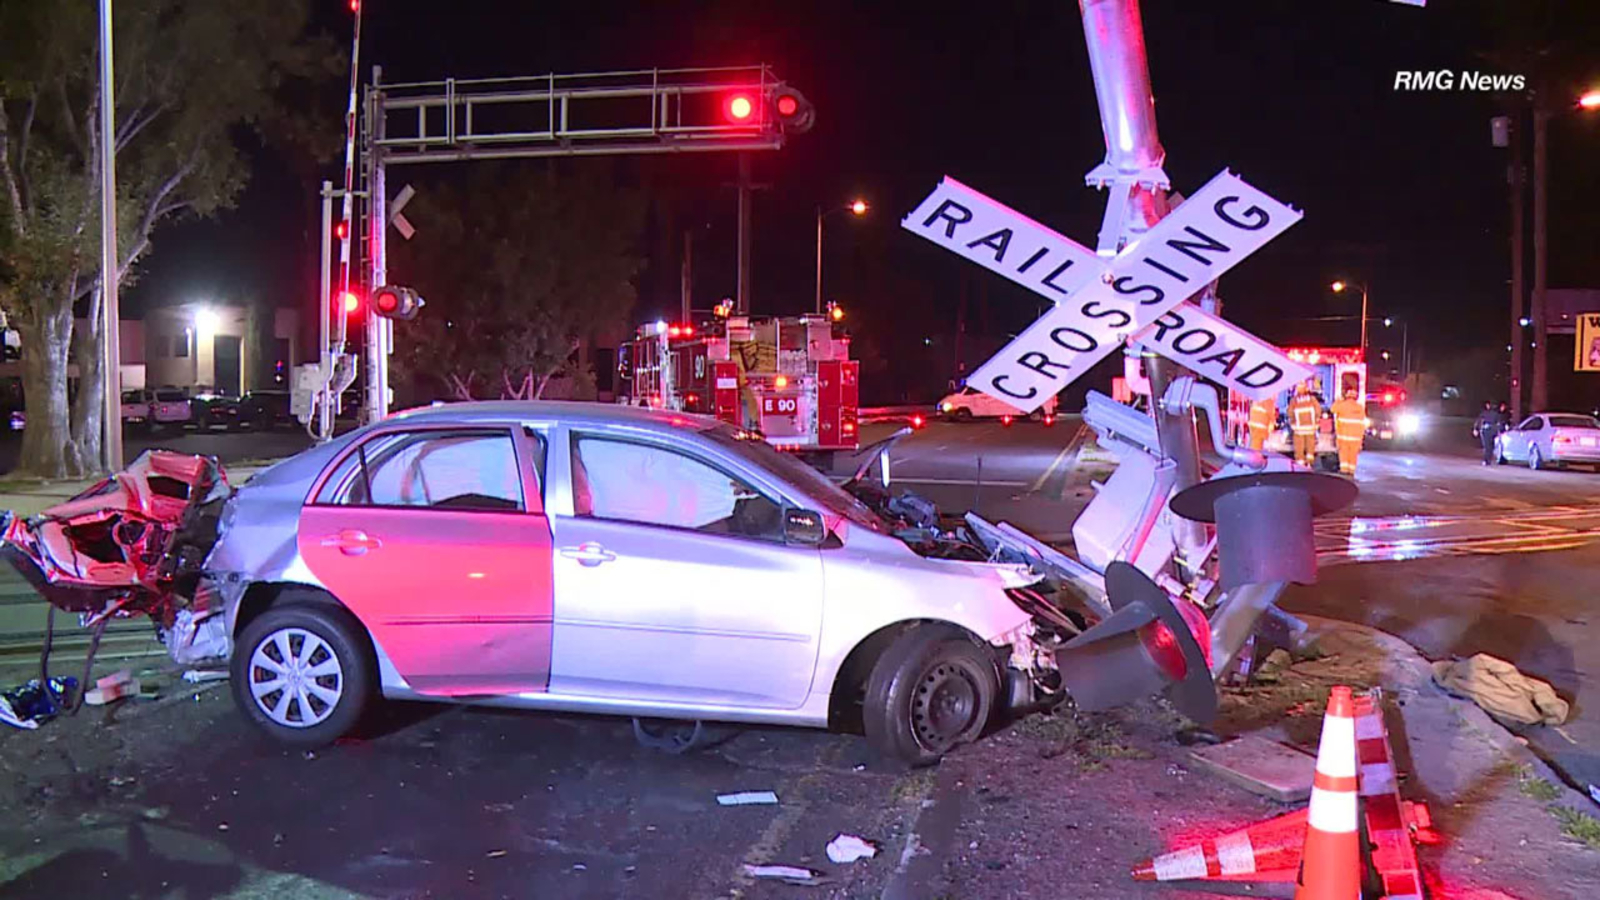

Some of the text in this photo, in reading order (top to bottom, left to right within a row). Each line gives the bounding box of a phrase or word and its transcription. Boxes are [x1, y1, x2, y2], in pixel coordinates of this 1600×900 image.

[922, 198, 1284, 389] RAIL ROAD
[991, 195, 1271, 401] CROSSING
[694, 354, 705, 379] 90
[764, 399, 796, 412] E 90
